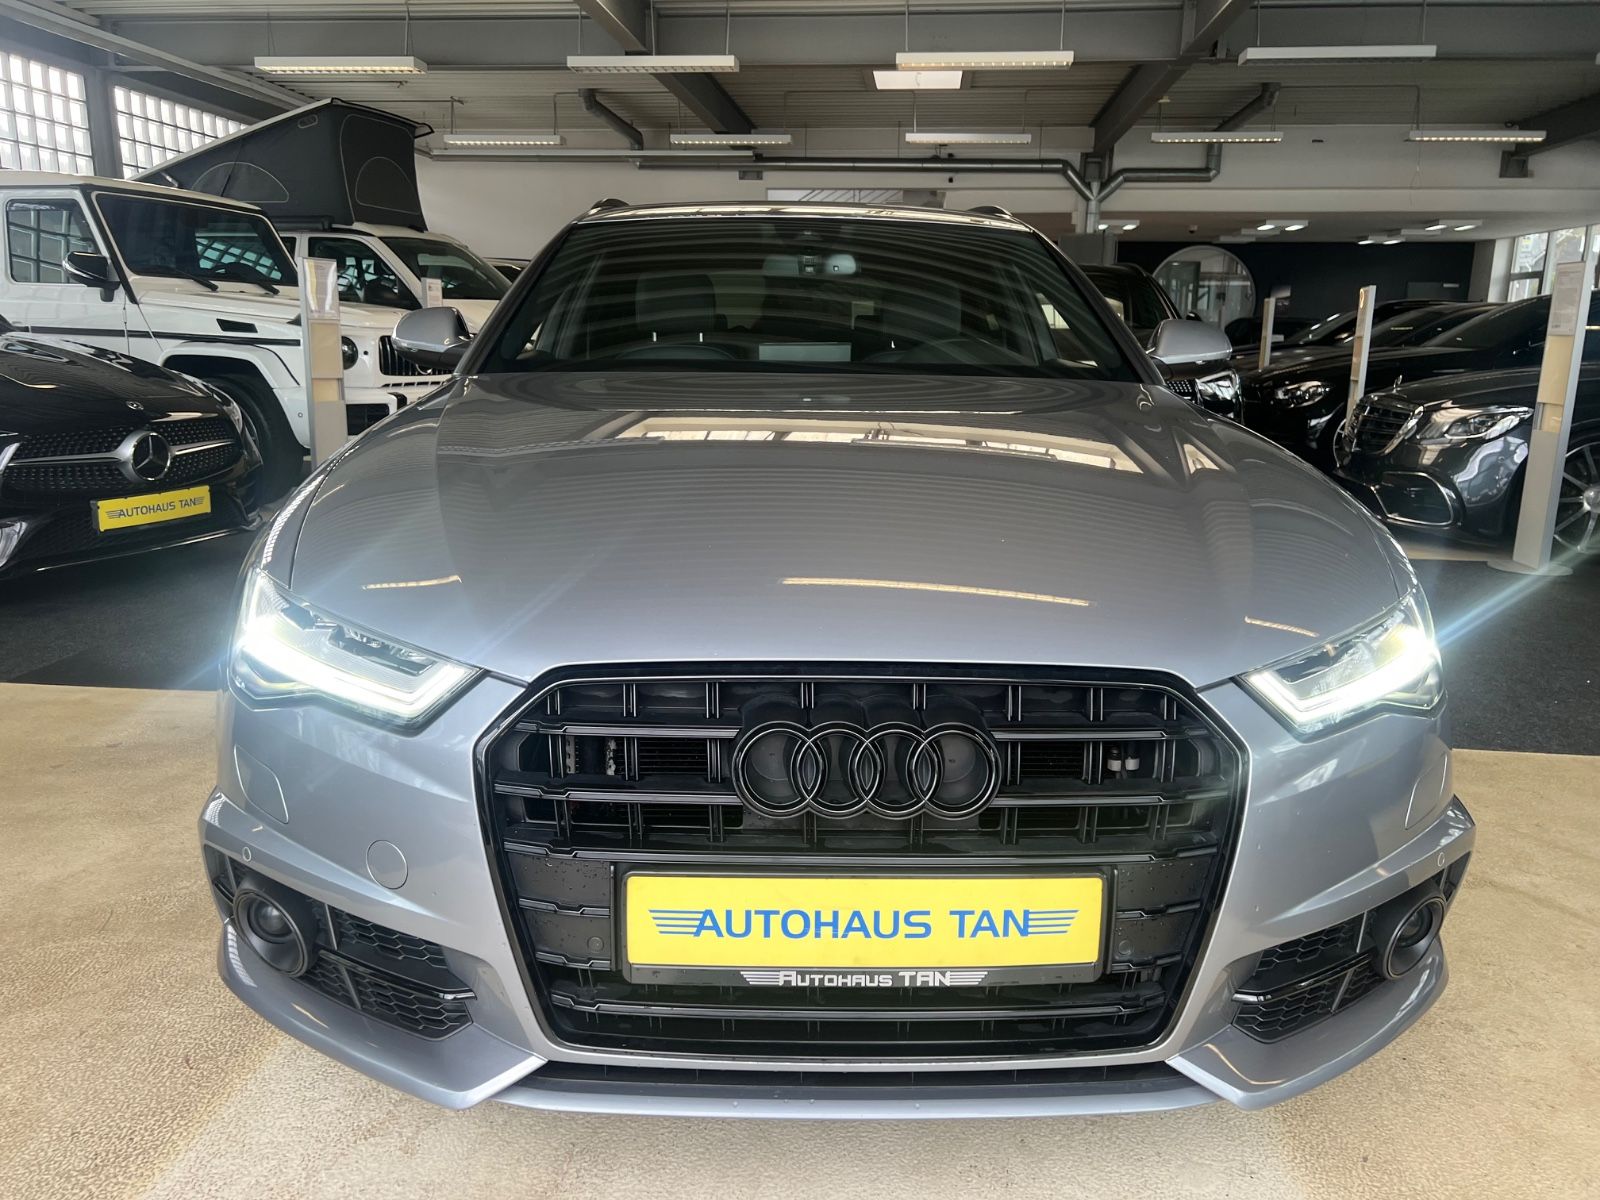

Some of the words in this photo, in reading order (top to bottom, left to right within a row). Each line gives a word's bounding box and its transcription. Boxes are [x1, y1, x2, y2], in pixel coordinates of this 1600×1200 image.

[118, 501, 176, 518] AUTOHAUS
[179, 498, 197, 509] TAN
[693, 909, 932, 939] AUTOHAUS
[949, 909, 1030, 938] TAN
[898, 971, 951, 987] TAN
